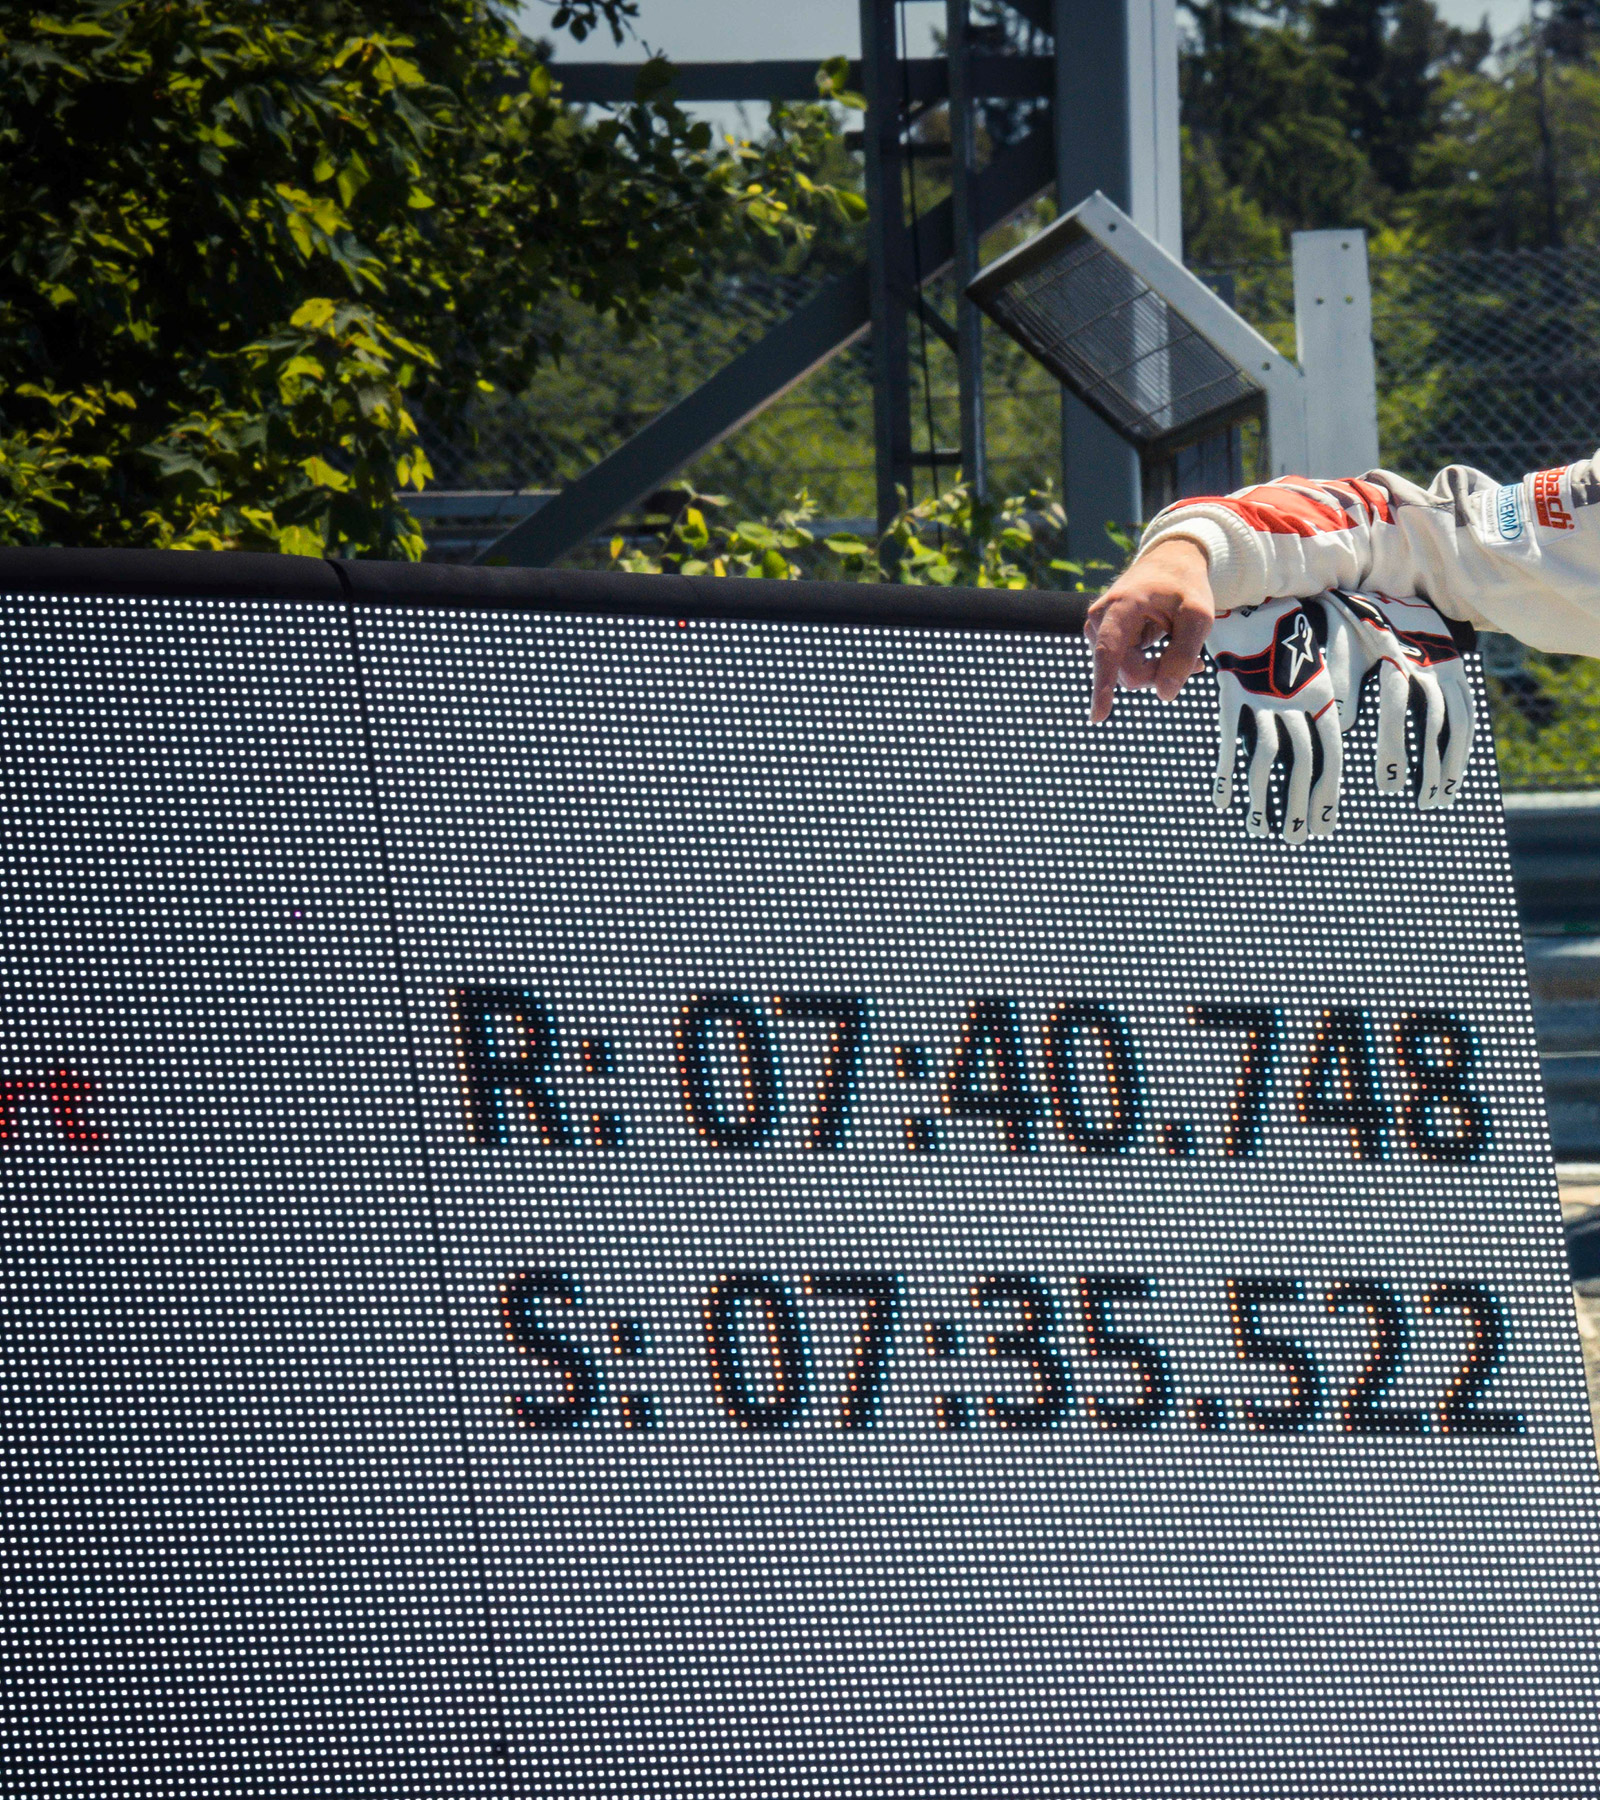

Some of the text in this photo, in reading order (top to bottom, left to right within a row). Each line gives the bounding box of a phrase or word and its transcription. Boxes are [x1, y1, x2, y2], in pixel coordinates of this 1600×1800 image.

[1386, 763, 1398, 781] 5
[1444, 779, 1457, 796] 2
[1321, 805, 1333, 822] 2
[1292, 817, 1305, 833] 4
[452, 988, 1495, 1165] R: 07:40.748
[504, 1270, 1526, 1435] S: 07:35.522
